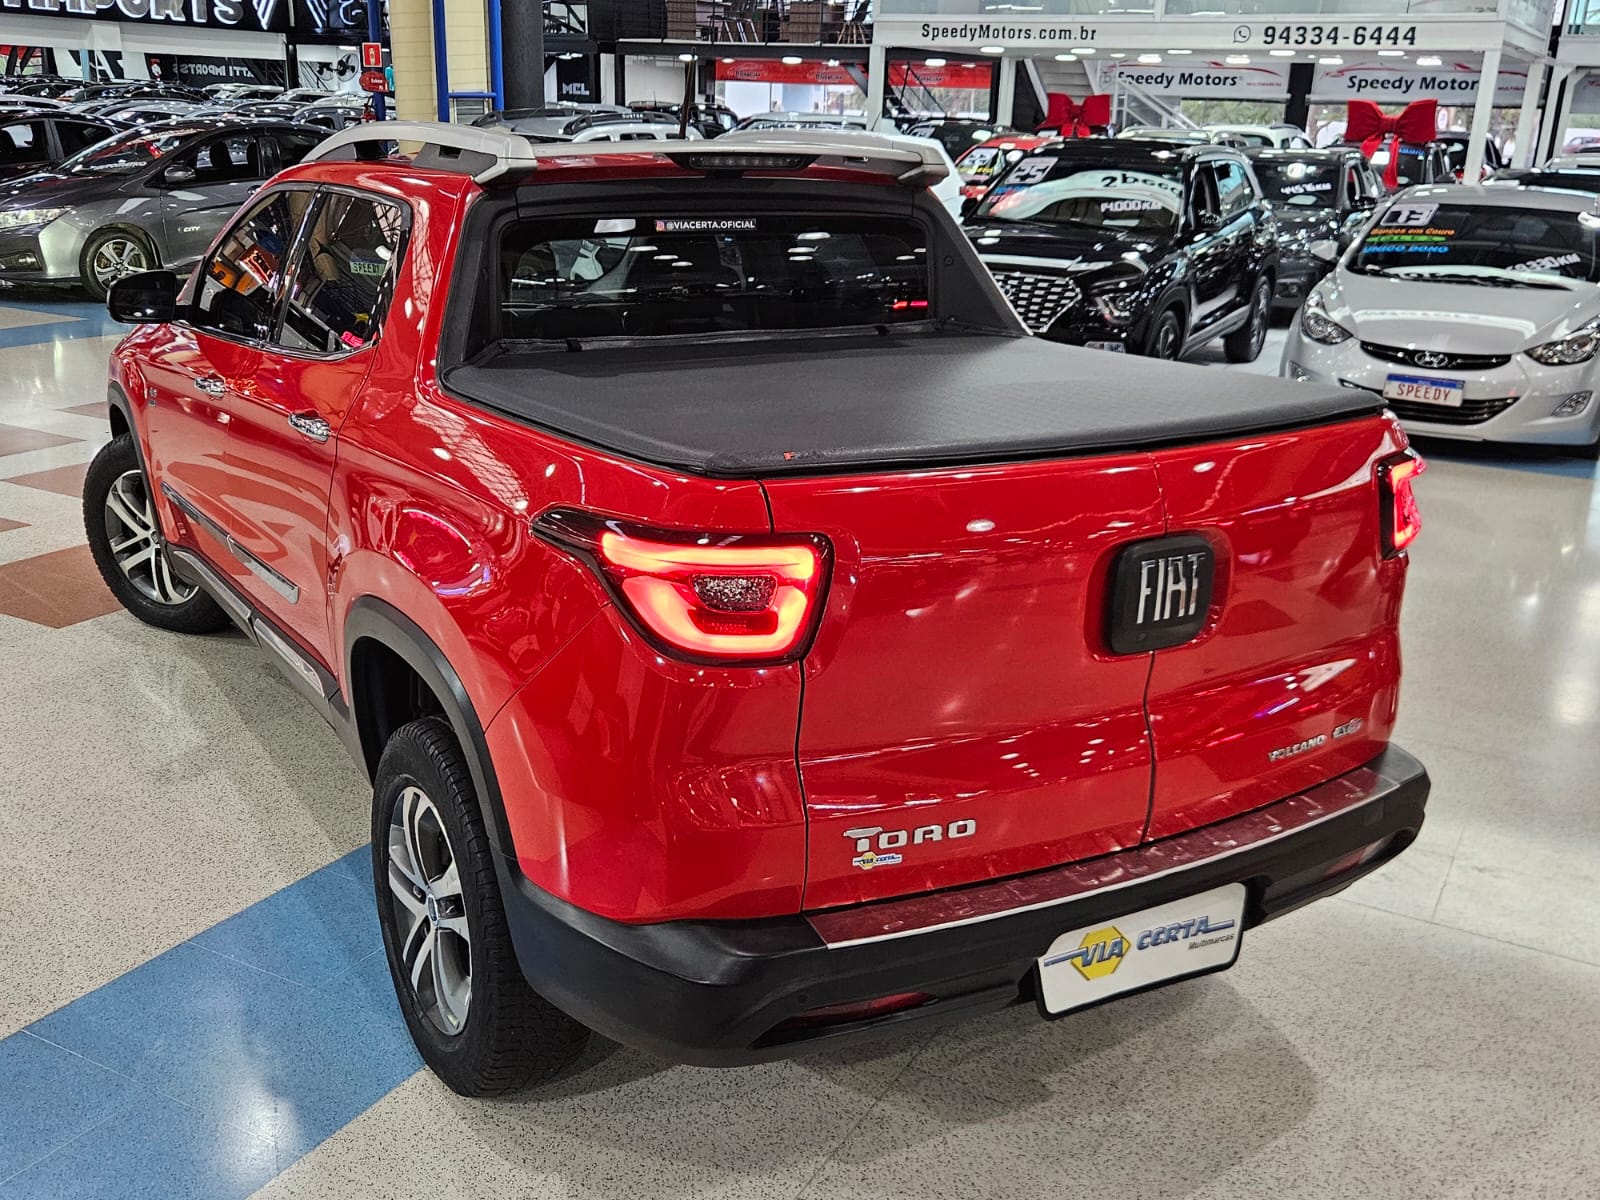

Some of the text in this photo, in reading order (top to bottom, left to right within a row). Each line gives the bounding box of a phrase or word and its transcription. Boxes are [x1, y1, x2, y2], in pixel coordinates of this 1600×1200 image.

[28, 0, 244, 25] ORTS
[921, 22, 1097, 42] SpeedyMotors.com.br
[1263, 25, 1417, 46] 94334-6444
[1178, 72, 1238, 87] Motors
[1347, 75, 1479, 94] Speedy Motor
[666, 220, 756, 231] @VIACERTA.OFICIAL
[1396, 383, 1451, 401] SPEEDY
[1136, 551, 1206, 625] FIAT
[843, 819, 977, 853] TORO
[1062, 916, 1222, 968] VIA CERTA
[1187, 932, 1236, 951] Multimarcas
